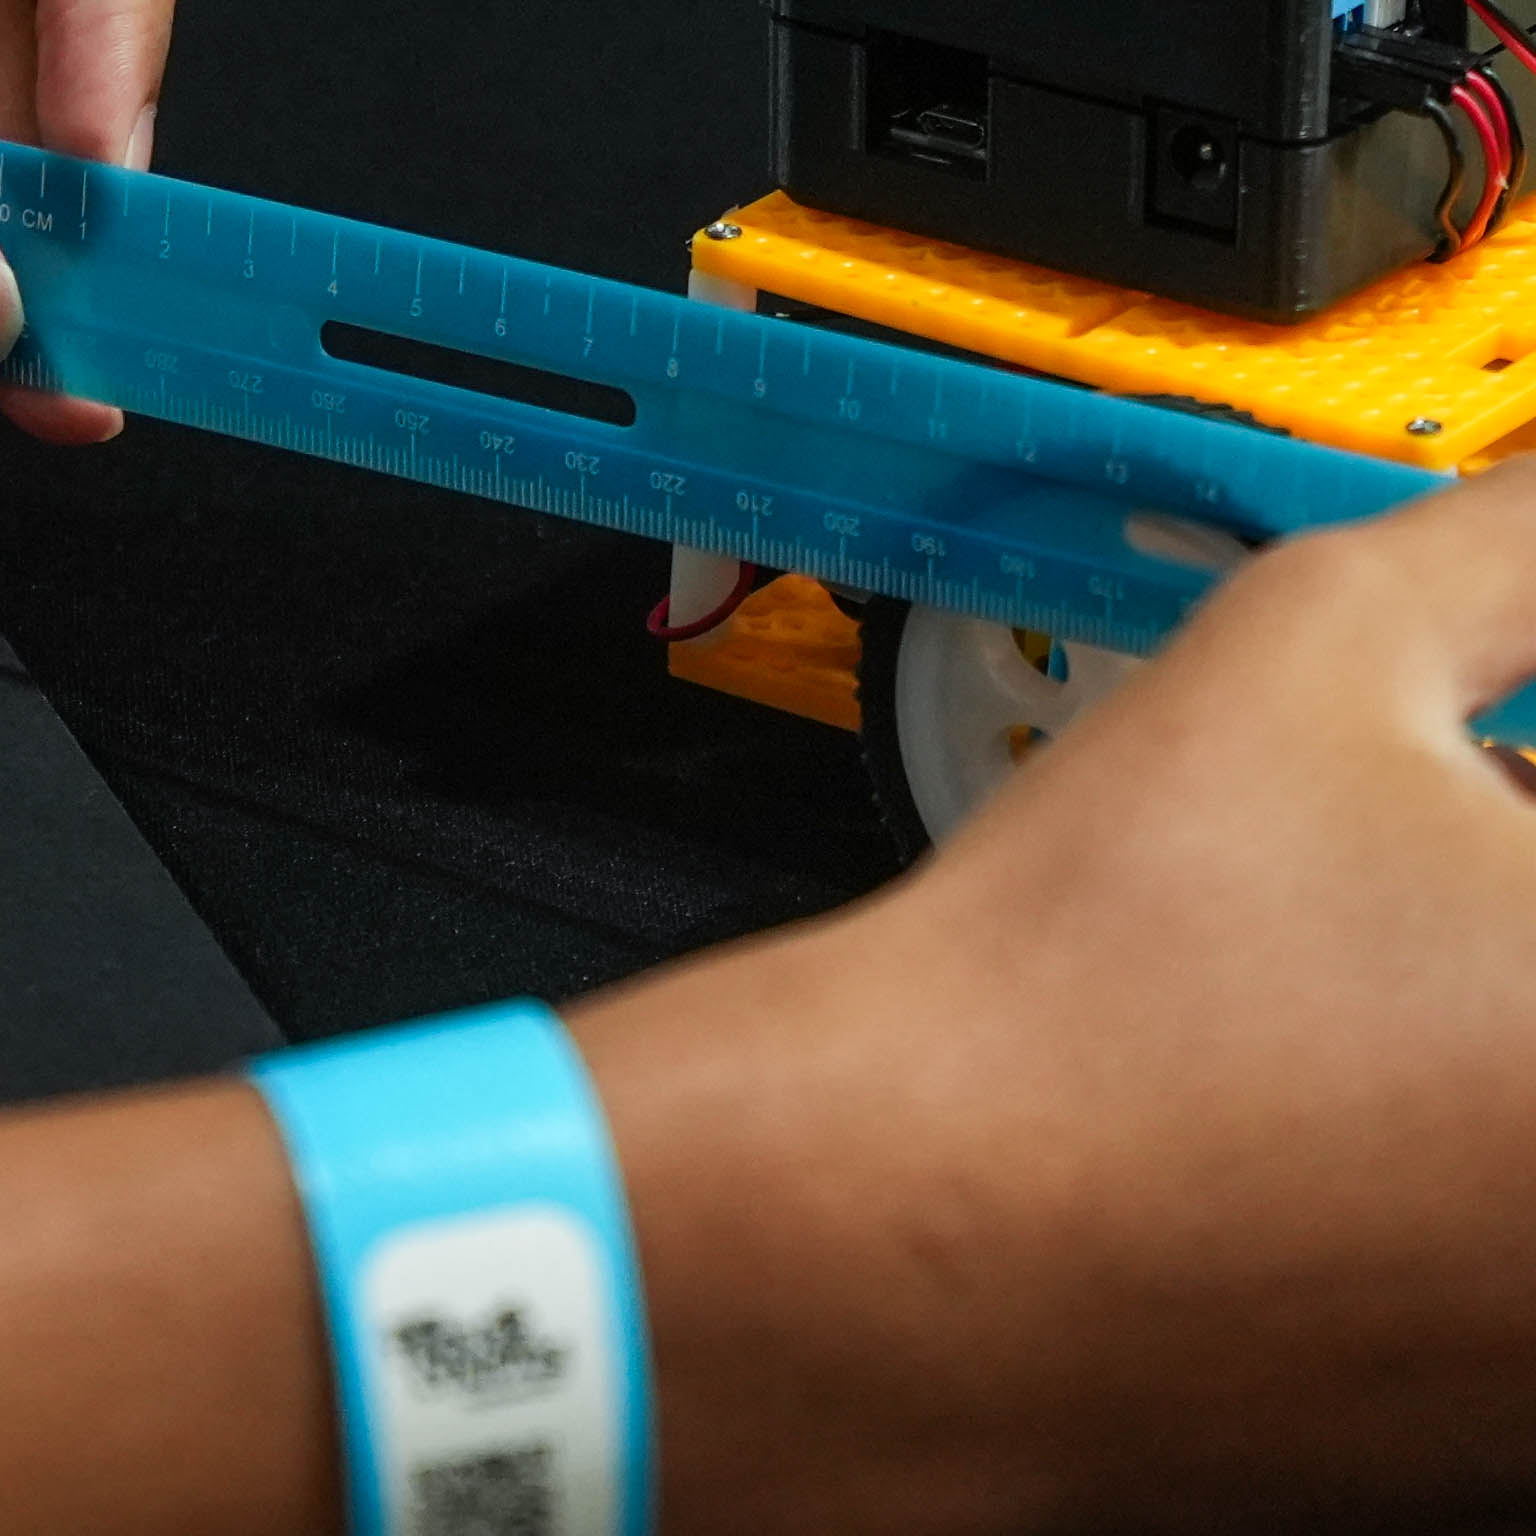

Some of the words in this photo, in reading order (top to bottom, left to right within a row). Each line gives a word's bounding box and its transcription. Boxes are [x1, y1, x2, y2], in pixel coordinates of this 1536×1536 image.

[21, 209, 54, 233] CM
[78, 221, 87, 240] 1
[158, 240, 171, 260] 2
[243, 258, 255, 279] 3
[327, 280, 339, 298] 4
[410, 298, 424, 318] 5
[495, 318, 508, 337] 6
[582, 338, 595, 358] 7
[666, 359, 679, 379] 8
[754, 379, 767, 399] 9
[837, 399, 860, 420] 10
[928, 419, 948, 440] 11
[1015, 441, 1037, 463] 12
[394, 408, 431, 435] 250
[480, 431, 516, 456] 240
[565, 450, 601, 476] 230
[649, 471, 686, 496] 220
[735, 489, 774, 517] 210
[822, 510, 861, 537] 200
